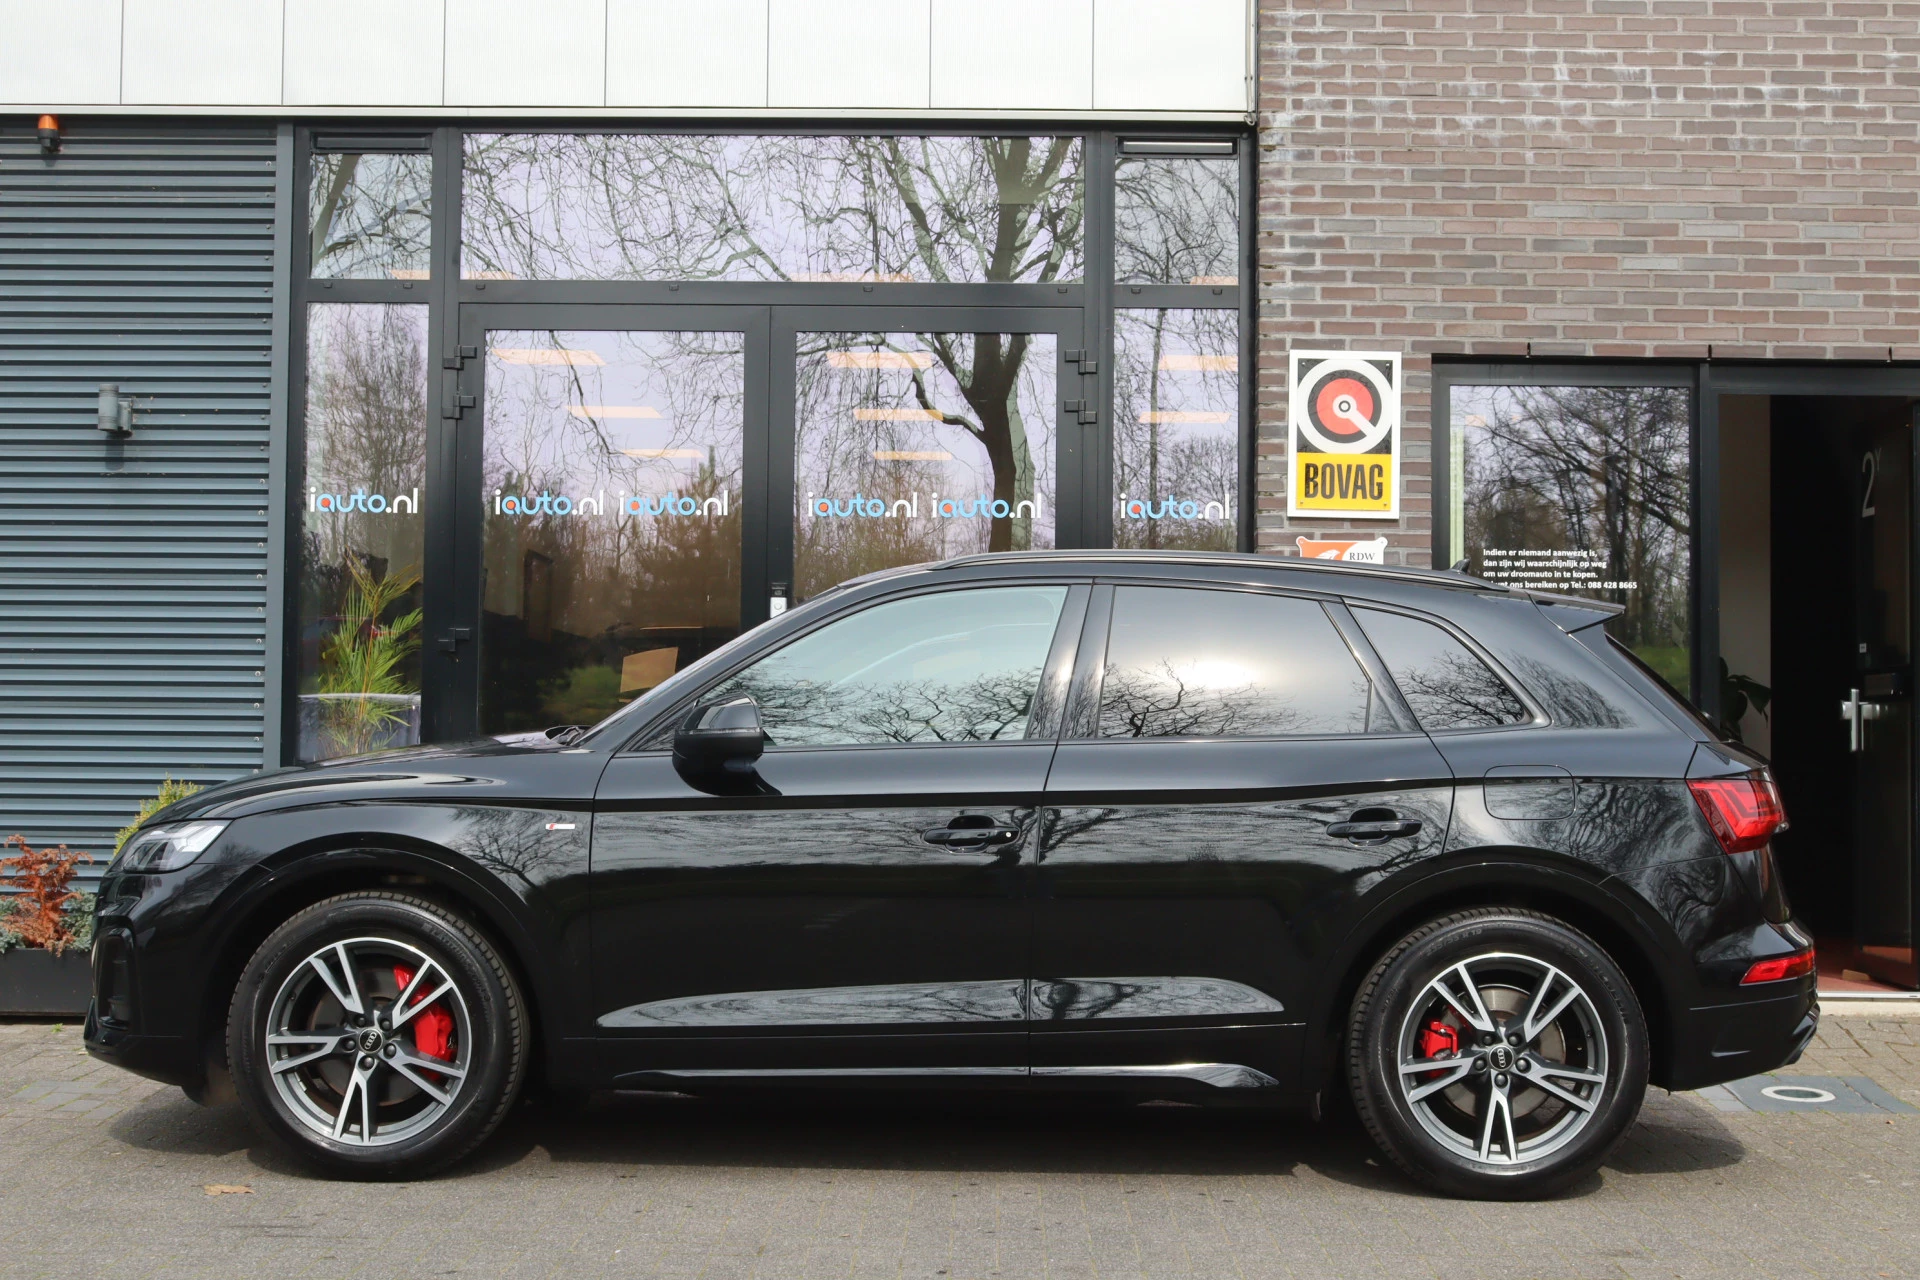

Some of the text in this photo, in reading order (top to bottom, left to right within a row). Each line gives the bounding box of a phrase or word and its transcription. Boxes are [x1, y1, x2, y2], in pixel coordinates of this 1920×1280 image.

[1304, 462, 1384, 501] BOVAG
[309, 486, 419, 514] iauto.nl
[495, 488, 604, 516] iauto.nl
[619, 489, 729, 517] iauto.nl
[808, 491, 918, 518] iauto.nl
[931, 491, 1042, 519] iauto.nl
[1120, 492, 1230, 520] iauto.nl
[1349, 552, 1375, 561] RDW
[1483, 548, 1507, 556] Indien
[1518, 548, 1551, 556] niemand
[1553, 549, 1588, 558] aanwezig
[1589, 549, 1598, 557] is,
[1483, 559, 1498, 567] dan
[1499, 559, 1513, 568] zijn
[1513, 559, 1526, 568] wij
[1526, 559, 1578, 568] waarschijnlijk
[1590, 561, 1607, 569] weg
[1524, 580, 1558, 589] bereiken
[1559, 582, 1569, 590] op
[1570, 581, 1587, 589] Tel.:
[1587, 581, 1602, 589] 088
[1603, 581, 1617, 589] 428
[1618, 581, 1638, 589] 8665
[1554, 570, 1562, 578] in
[1563, 570, 1571, 578] te
[1572, 570, 1598, 579] kopen.
